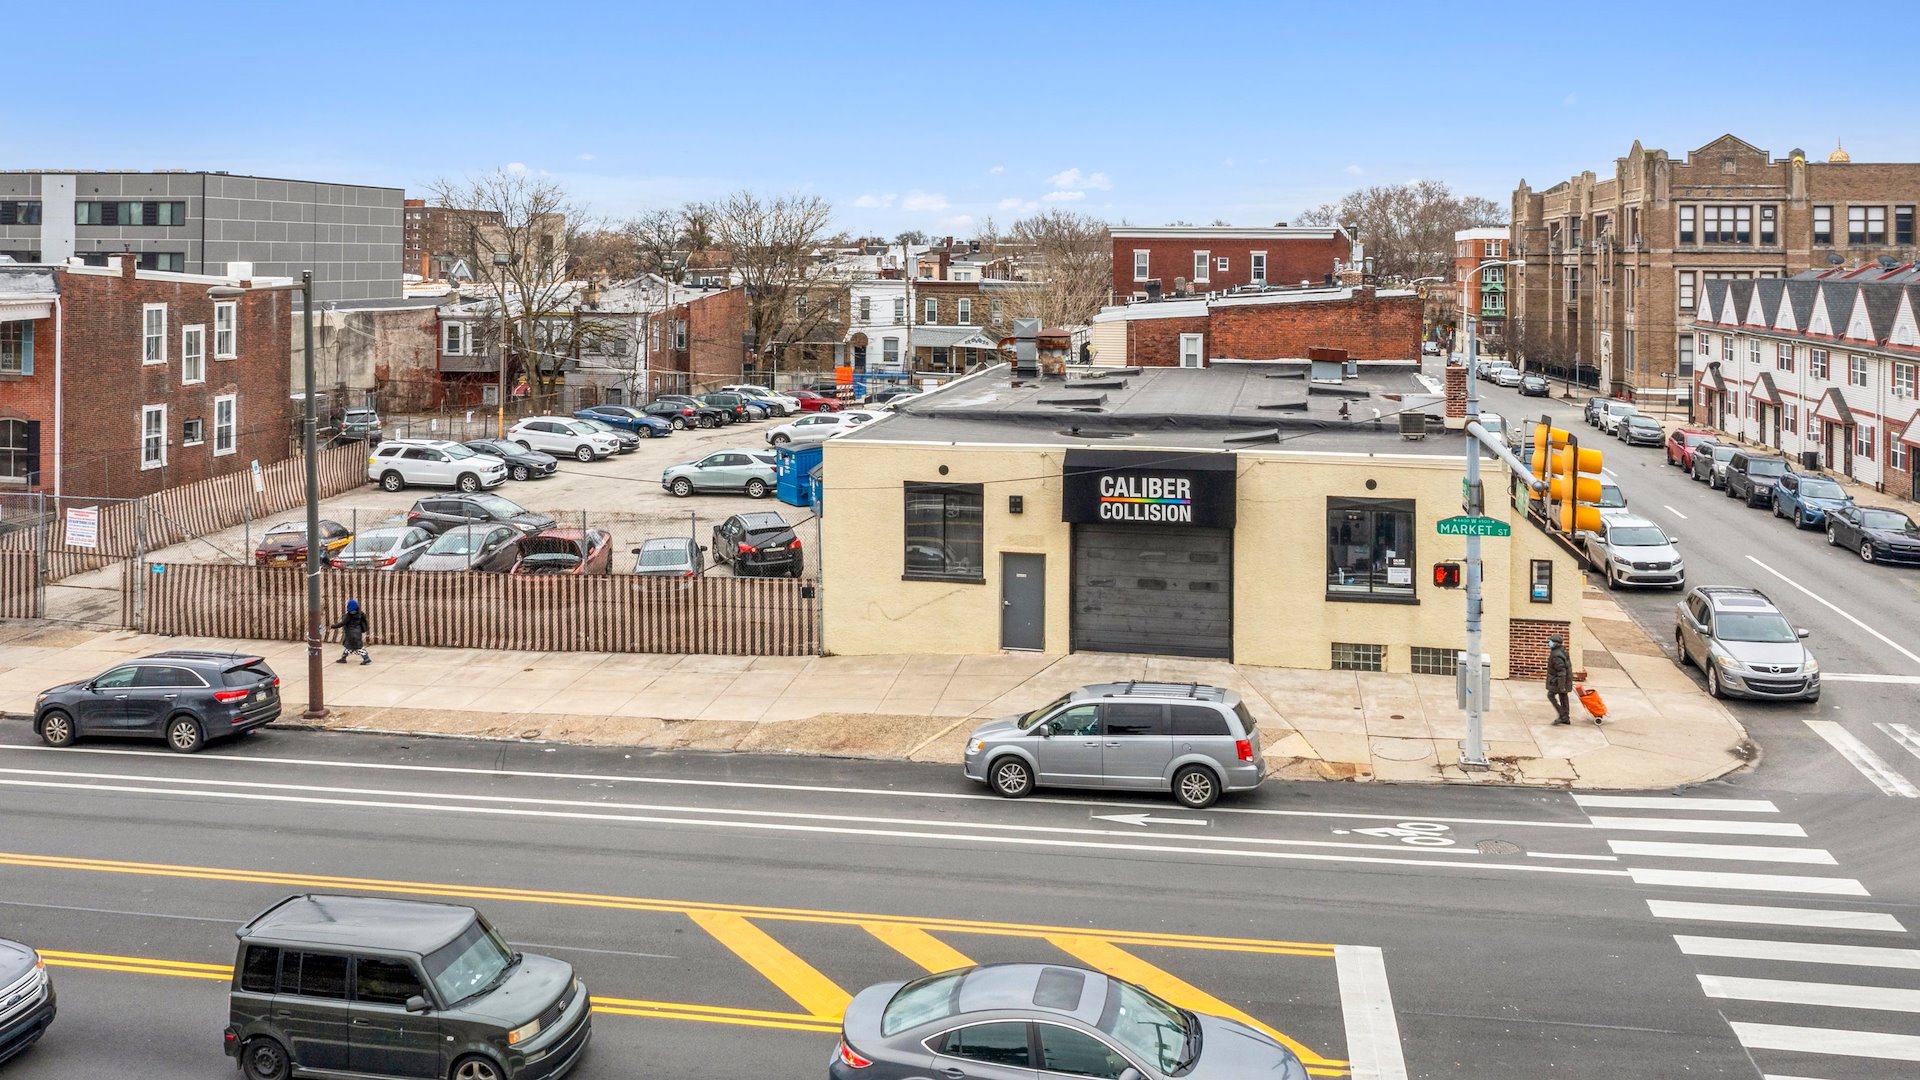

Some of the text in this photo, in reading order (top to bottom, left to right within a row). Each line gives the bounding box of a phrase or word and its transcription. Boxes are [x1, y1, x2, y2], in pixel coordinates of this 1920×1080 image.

[1100, 476, 1191, 499] CALIBER
[1100, 502, 1191, 522] COLLISION
[1440, 523, 1508, 536] MARKET ST
